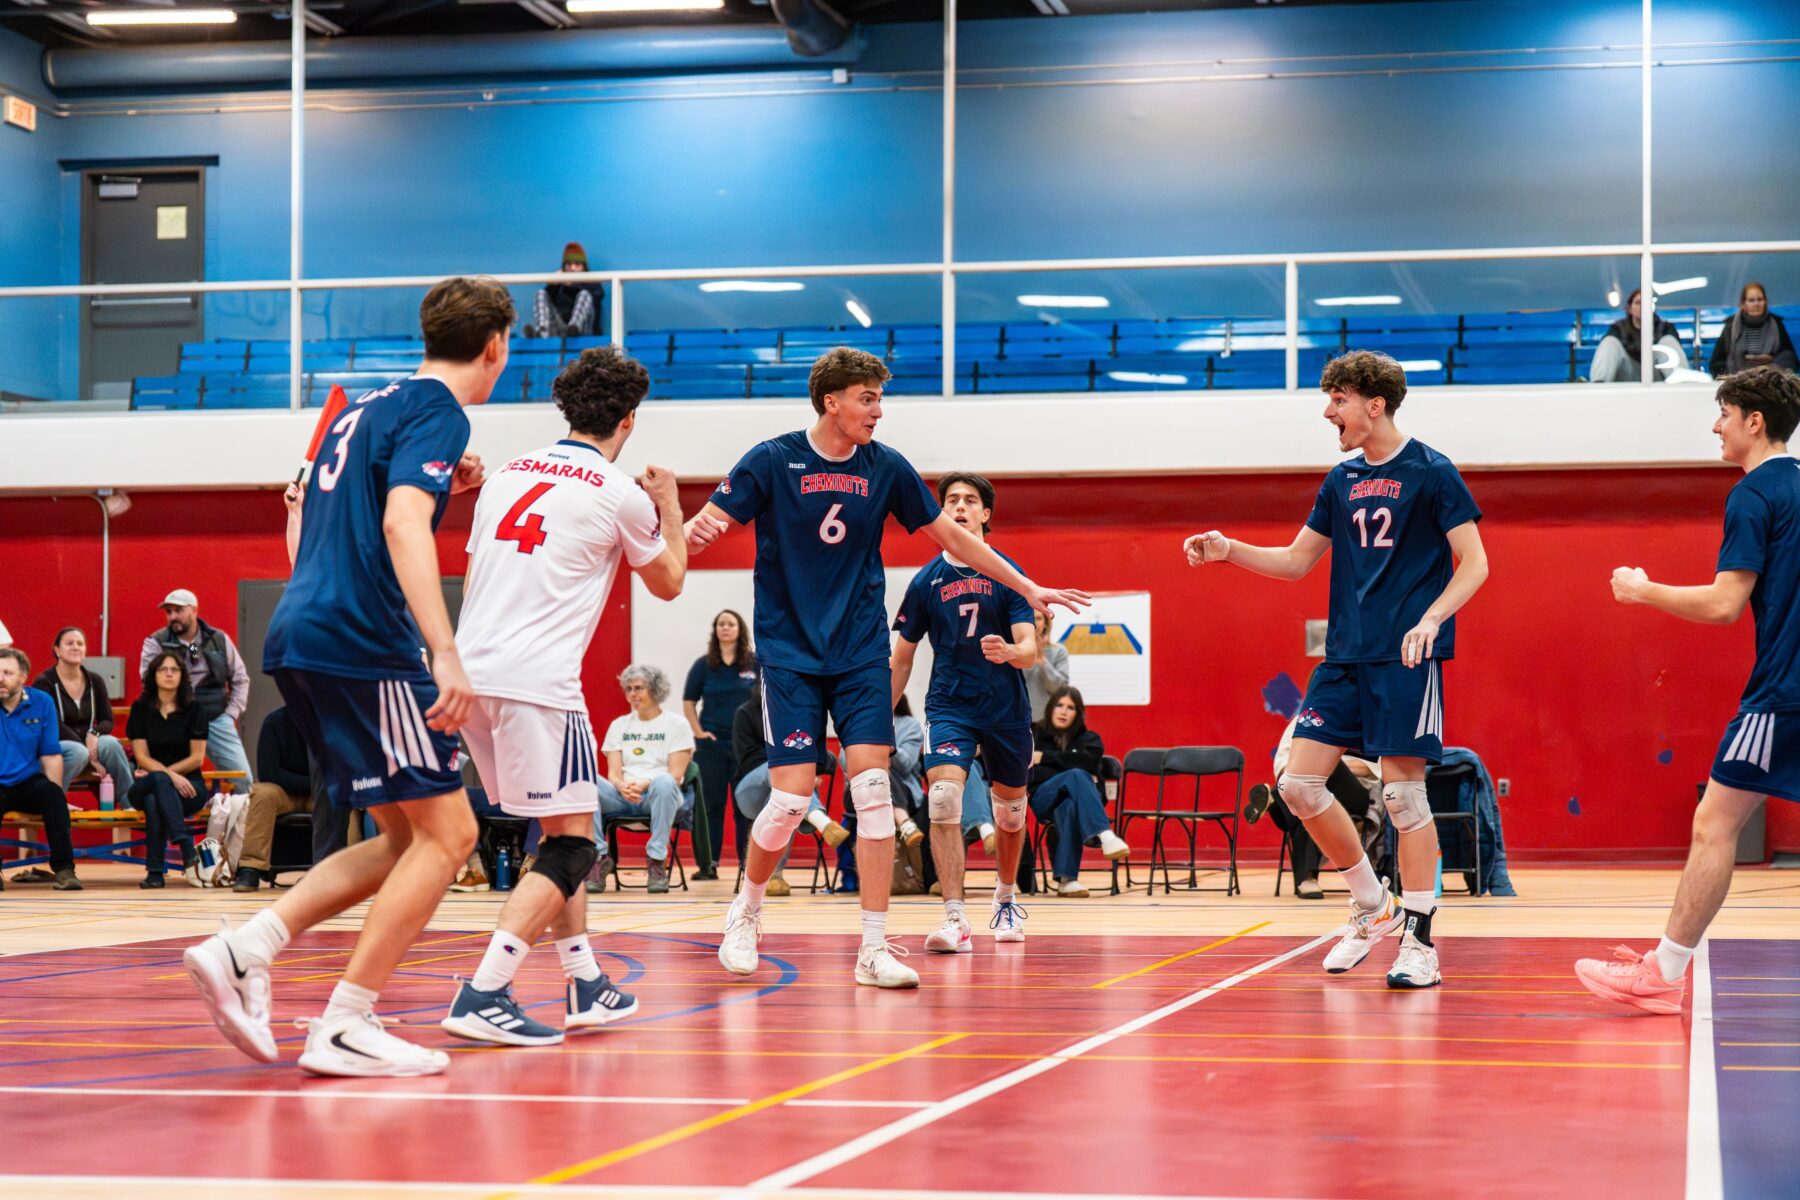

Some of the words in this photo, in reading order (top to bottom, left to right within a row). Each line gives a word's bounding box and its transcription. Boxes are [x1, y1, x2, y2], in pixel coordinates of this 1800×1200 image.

[318, 407, 365, 492] 3
[801, 473, 868, 496] CHEMINOTS
[1349, 479, 1402, 500] CHEMINOTS
[495, 482, 556, 555] 4
[819, 503, 847, 544] 6
[1352, 506, 1393, 548] 12
[959, 602, 979, 638] 7
